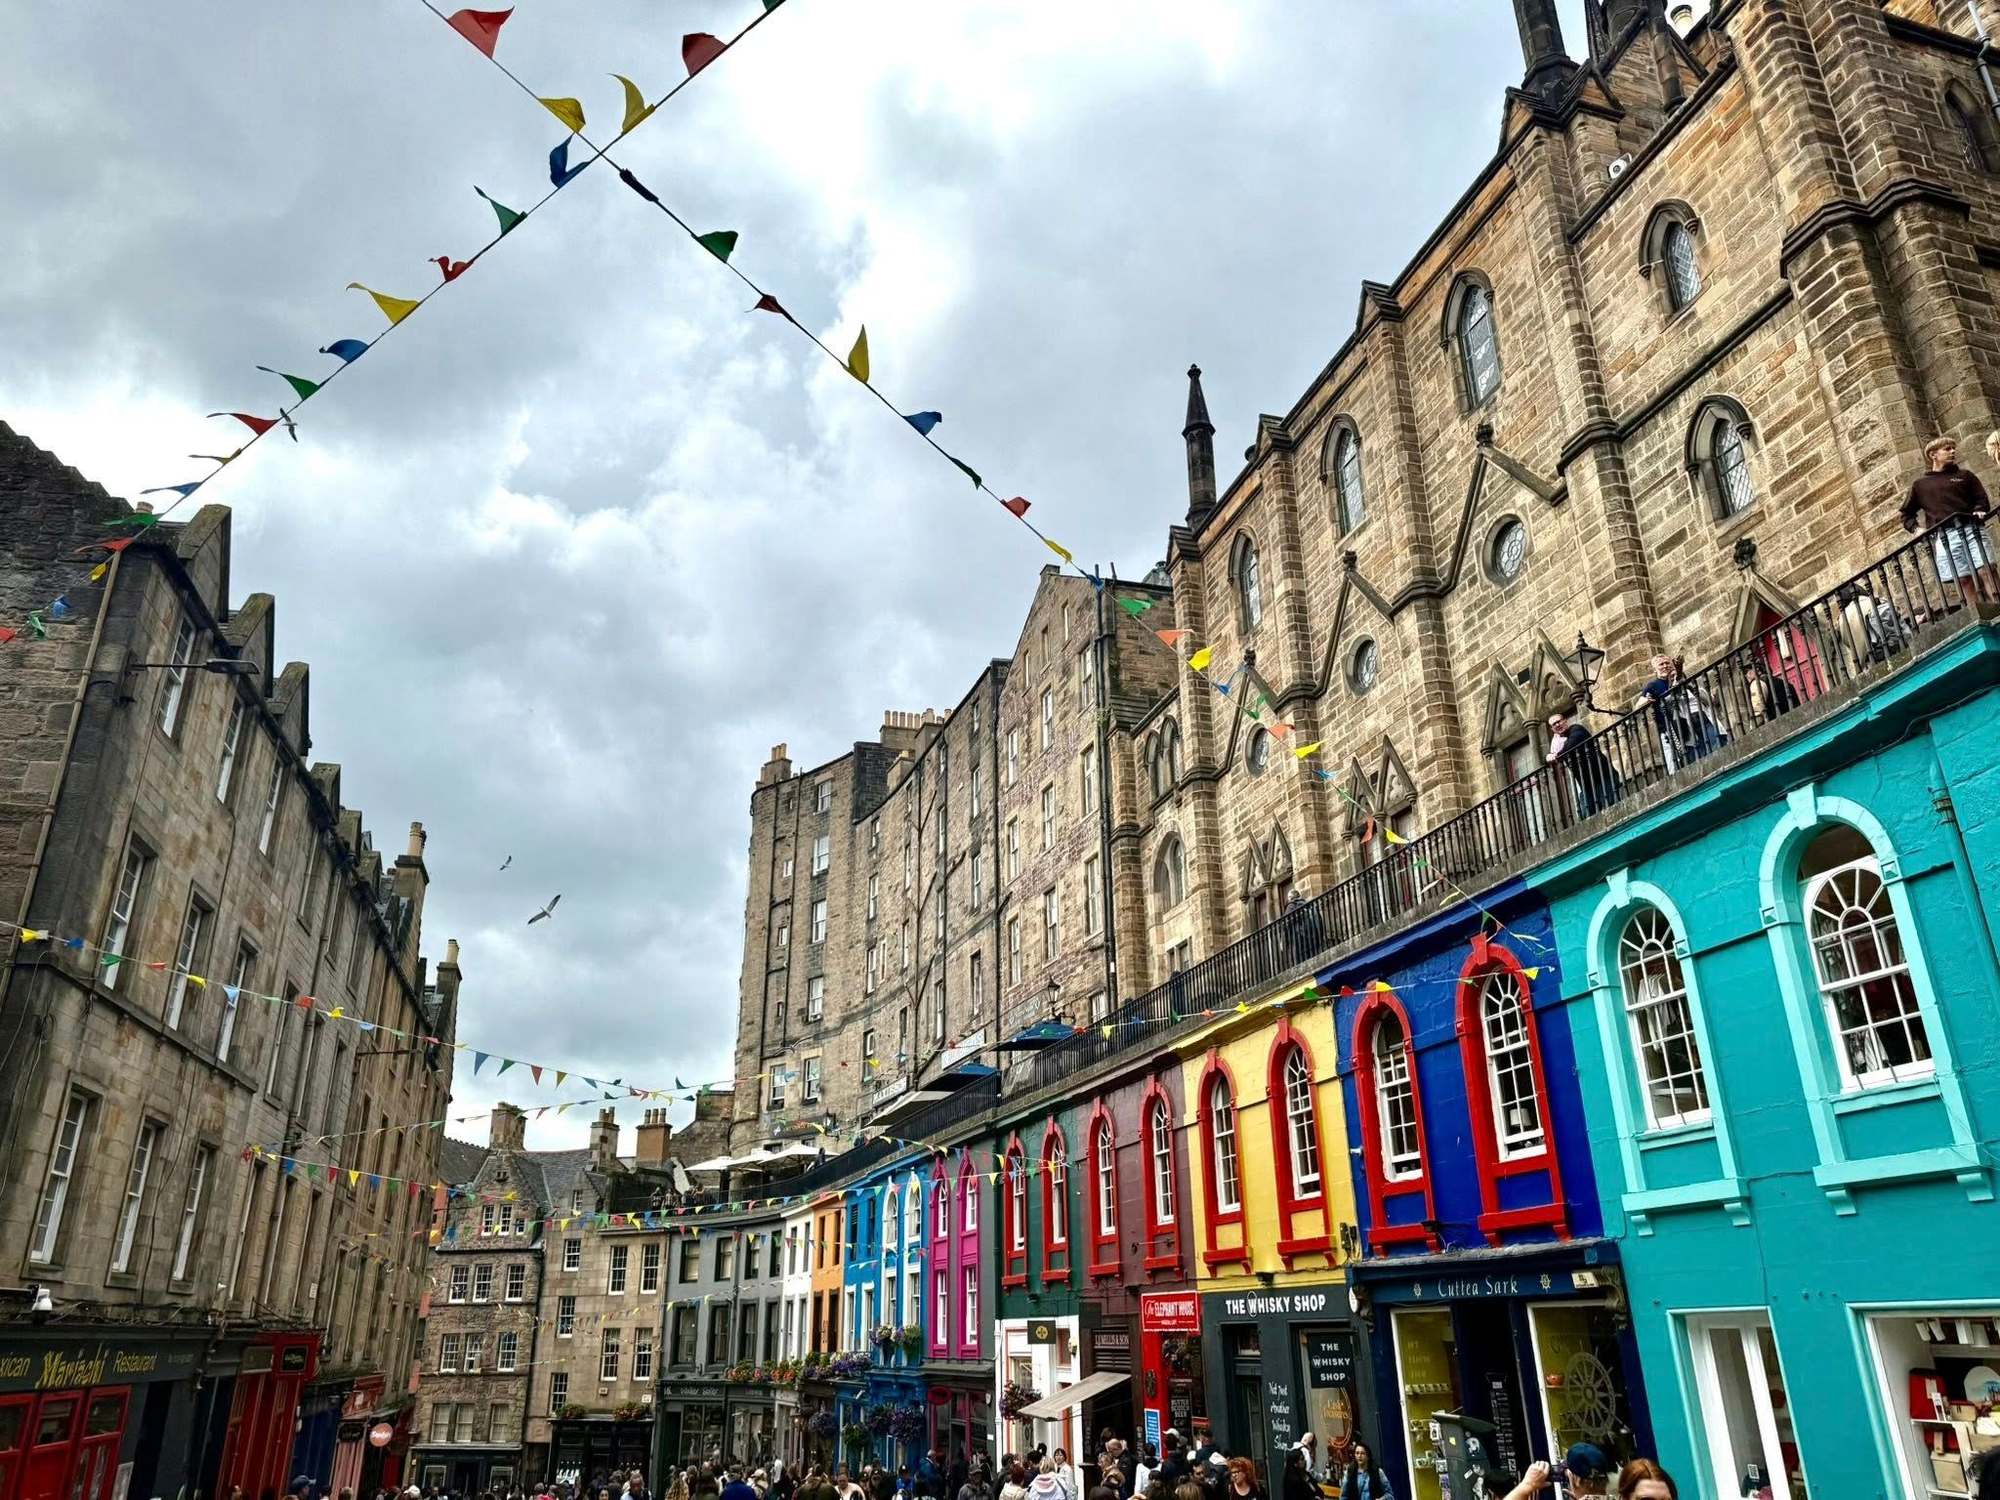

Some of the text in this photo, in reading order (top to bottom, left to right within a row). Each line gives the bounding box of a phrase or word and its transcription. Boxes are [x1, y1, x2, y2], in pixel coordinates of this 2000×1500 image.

[1437, 1274, 1518, 1297] Cuttea Sark
[1225, 1294, 1326, 1315] THE WHISKY SHOP
[1321, 1343, 1340, 1351] THE
[35, 1343, 109, 1389] Mariachi
[113, 1351, 158, 1373] Restaurant
[1312, 1358, 1350, 1368] WHISKY
[1320, 1373, 1346, 1381] SHOP
